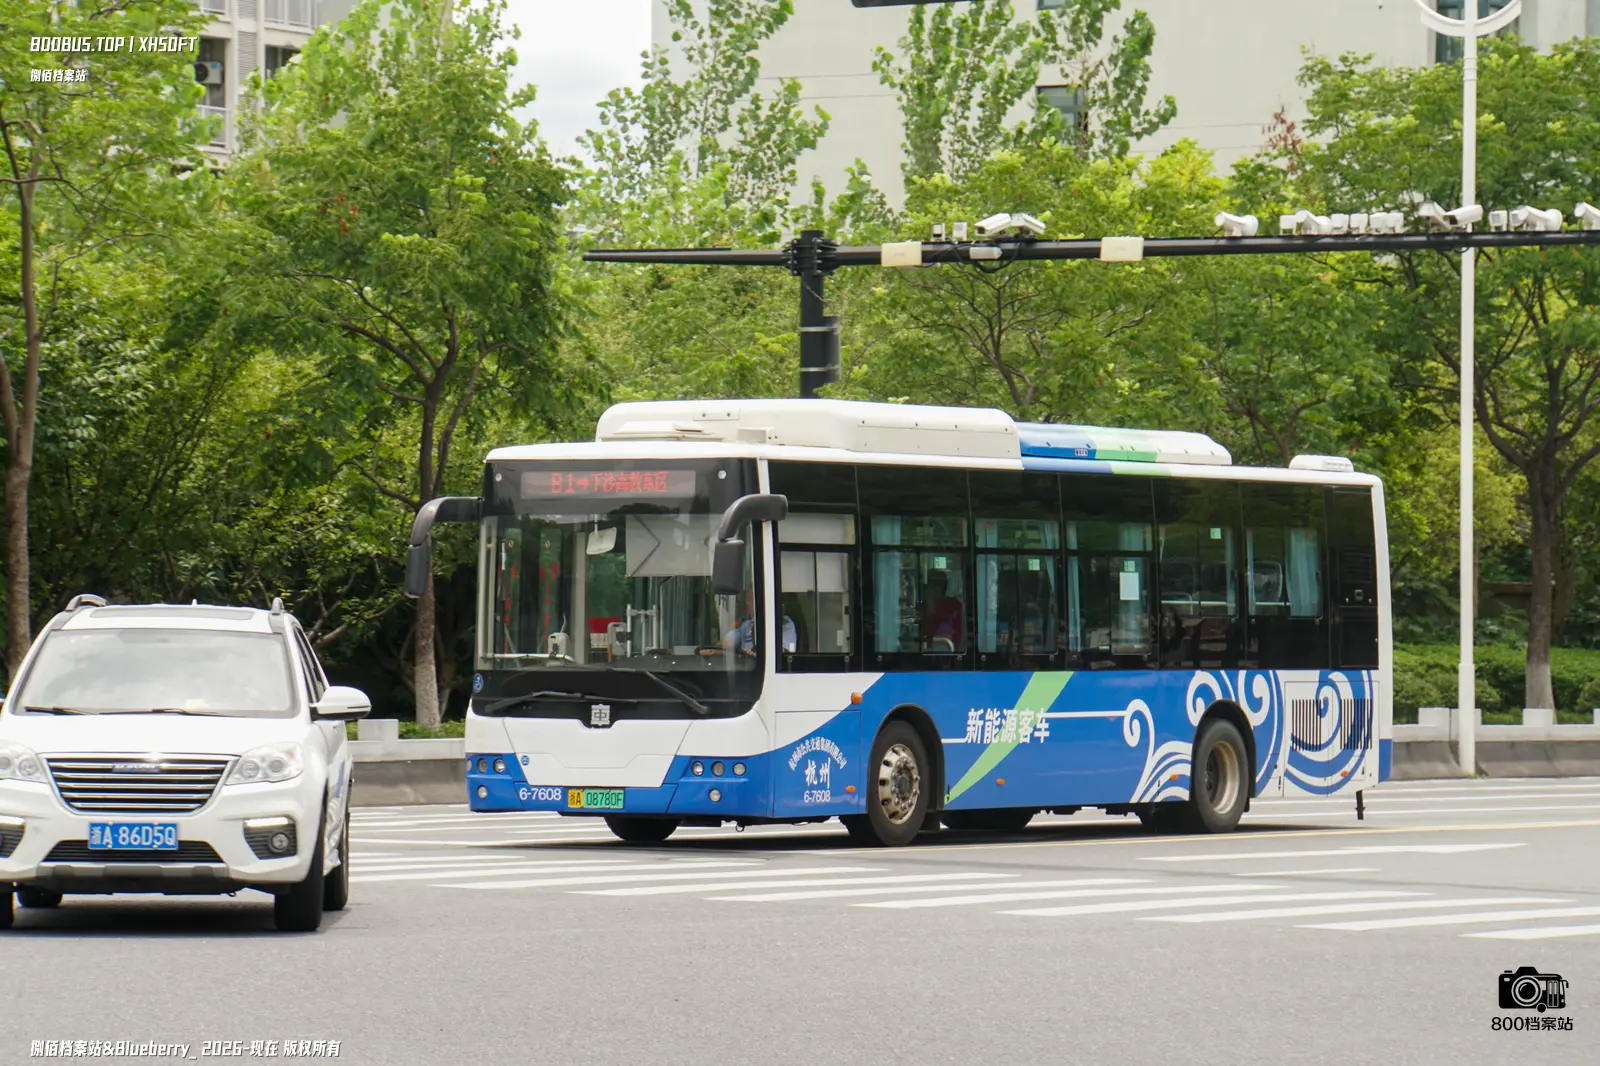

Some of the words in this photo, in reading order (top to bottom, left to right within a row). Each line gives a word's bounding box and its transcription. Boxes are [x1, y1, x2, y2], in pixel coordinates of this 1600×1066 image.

[551, 472, 575, 493] B1
[966, 708, 1050, 744] 新能源客车
[804, 757, 831, 789] 杭州
[519, 787, 562, 801] 6-7608
[803, 790, 831, 803] 6-7608
